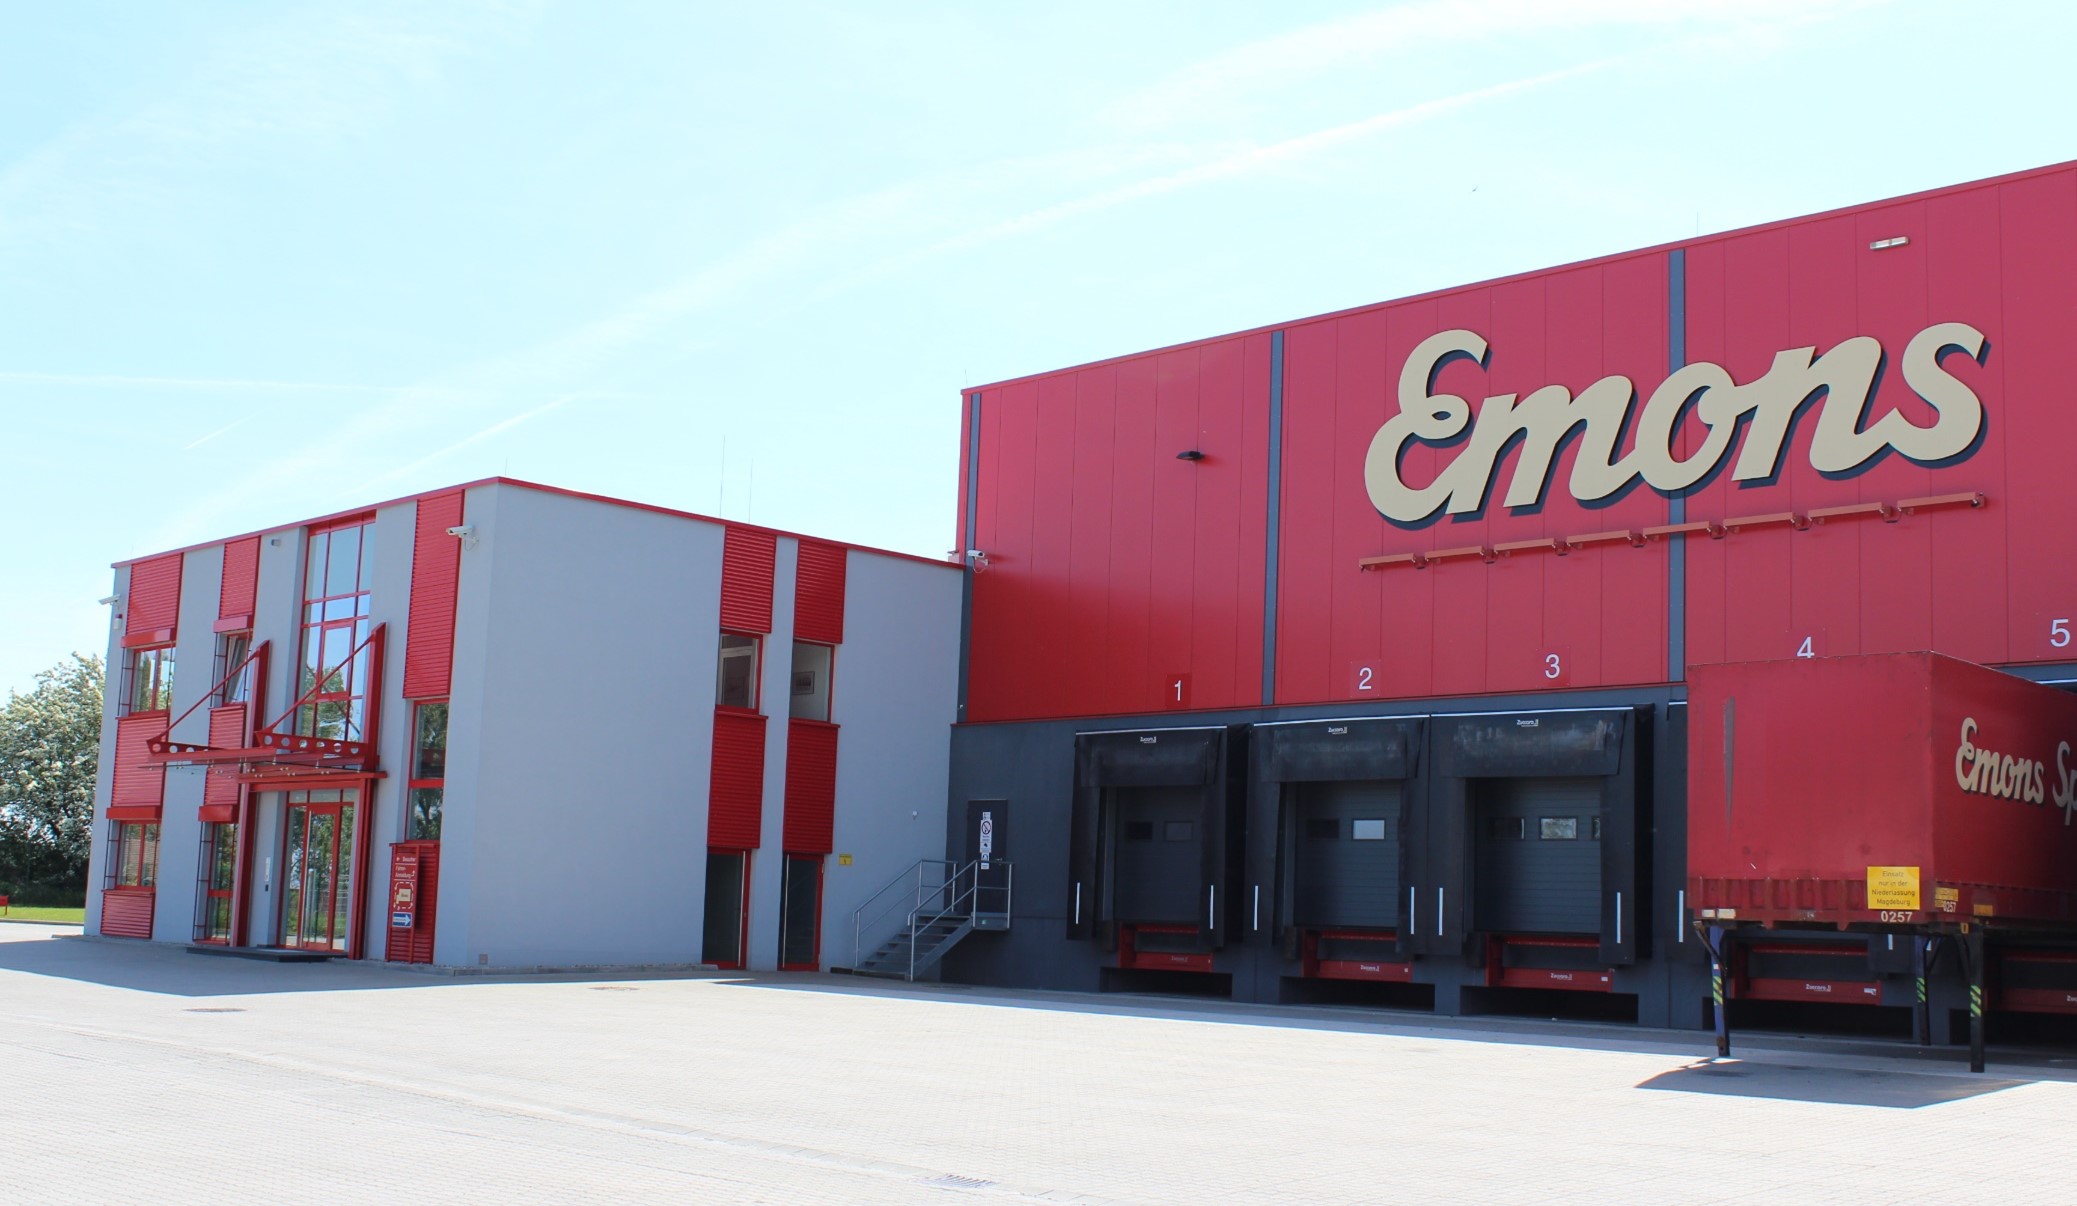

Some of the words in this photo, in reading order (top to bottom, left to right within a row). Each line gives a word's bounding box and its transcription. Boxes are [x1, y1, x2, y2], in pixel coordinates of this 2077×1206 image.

[1364, 322, 1988, 526] Emons
[2050, 618, 2071, 648] 5
[1796, 636, 1815, 659] 4
[1545, 653, 1560, 679] 3
[1174, 679, 1181, 701] 1
[1358, 667, 1372, 690] 2
[1955, 717, 2045, 805] Emons
[1871, 889, 1916, 897] Niederlassung
[1876, 899, 1911, 907] Magdeburg
[1880, 910, 1913, 923] 0257
